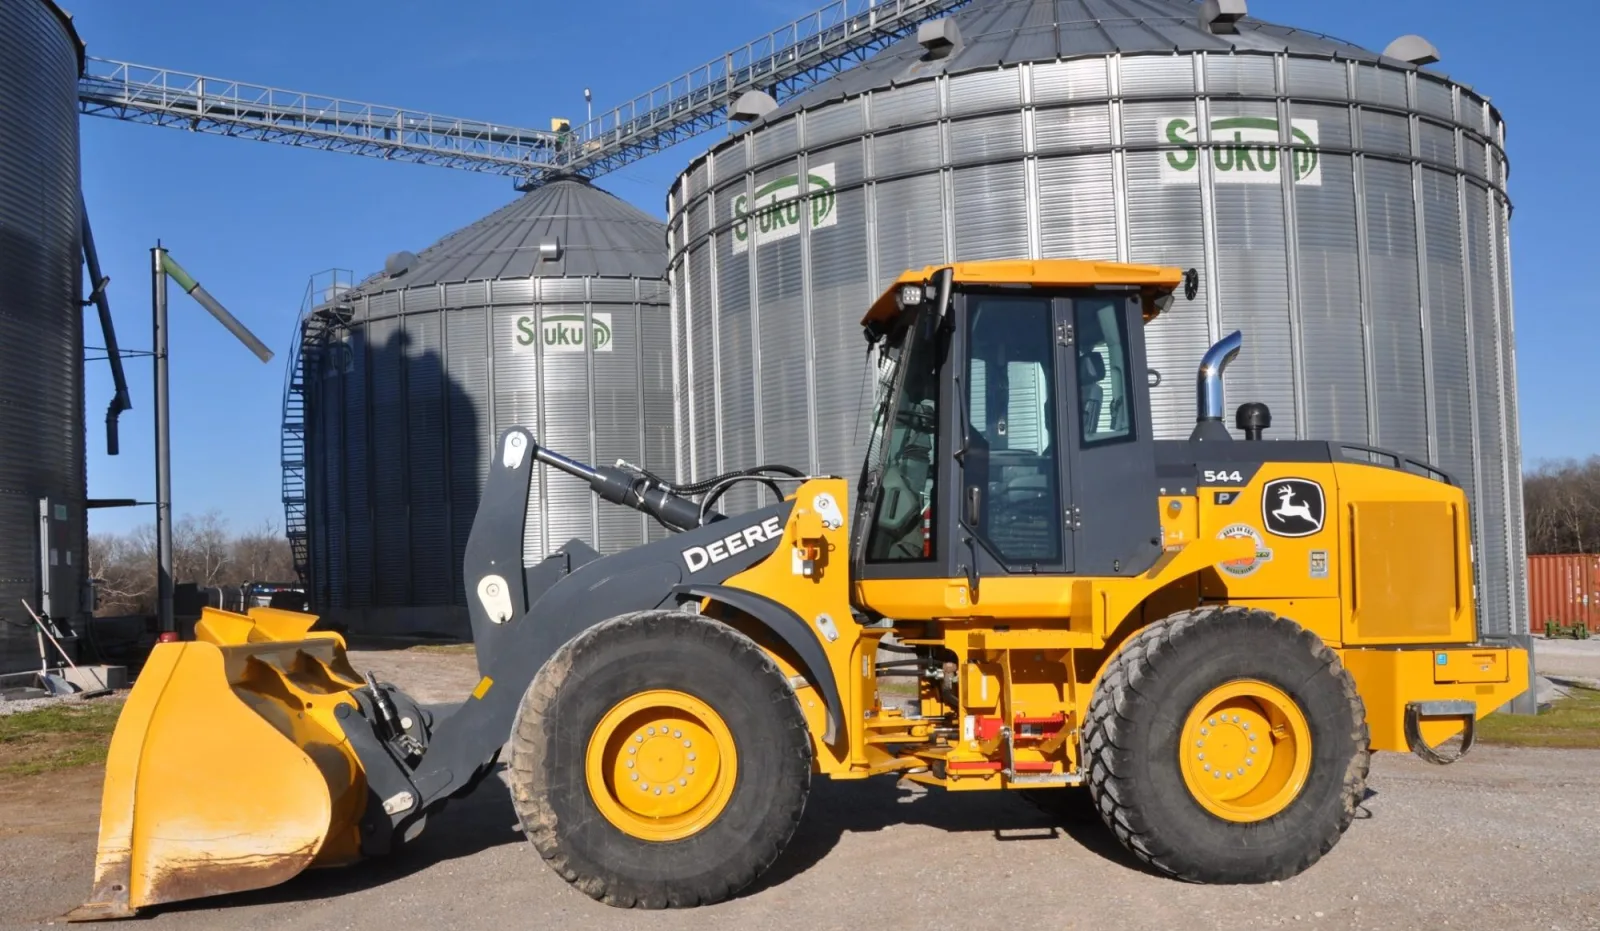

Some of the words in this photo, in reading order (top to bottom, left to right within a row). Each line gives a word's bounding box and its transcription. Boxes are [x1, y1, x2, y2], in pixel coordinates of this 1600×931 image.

[1166, 118, 1318, 182] Sukup
[735, 175, 835, 241] Sukup
[516, 315, 611, 350] Sukup
[1204, 470, 1243, 483] 544
[1218, 493, 1230, 504] P
[682, 516, 785, 574] DEERE
